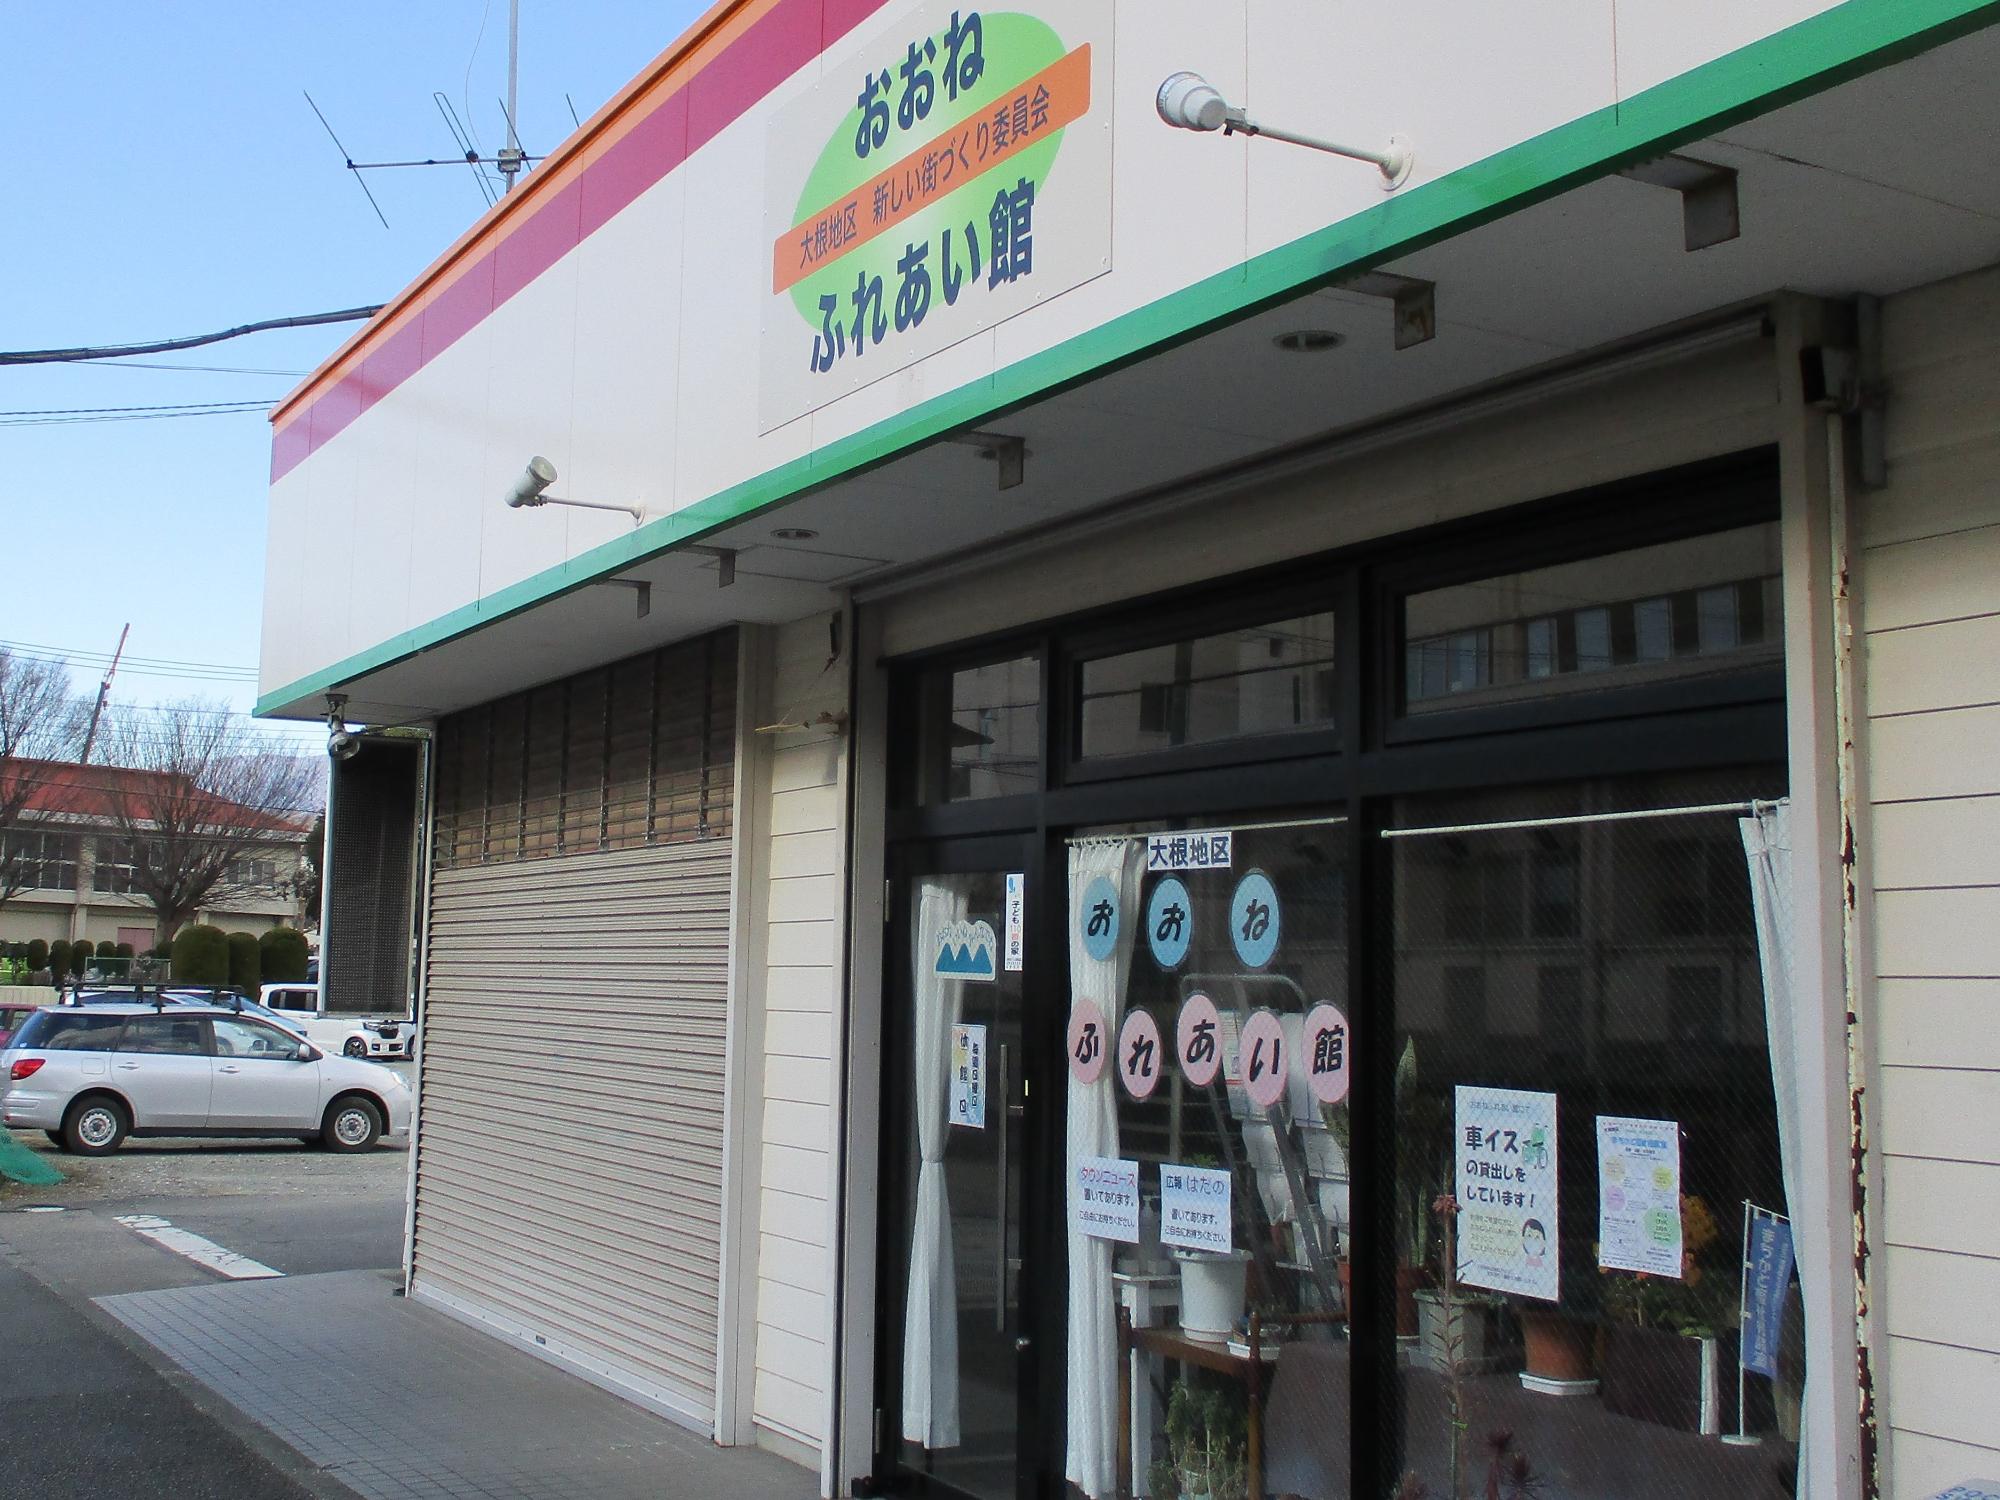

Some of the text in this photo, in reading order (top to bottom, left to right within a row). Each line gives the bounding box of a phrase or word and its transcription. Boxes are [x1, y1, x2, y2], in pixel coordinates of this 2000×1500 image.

[855, 10, 985, 158] おおね
[800, 84, 1050, 269] 大根地区 新しい街づくり委員会
[810, 177, 1035, 373] ふれあい館
[1150, 836, 1230, 868] 大根地区
[1088, 899, 1270, 941] おおね
[1075, 1023, 1344, 1082] ふれあい館
[1465, 1125, 1519, 1154] 車イス
[1081, 1167, 1136, 1188] タウンニュース
[1166, 1175, 1225, 1195] 広報 はだの
[1466, 1160, 1526, 1183] の貸出しを
[1467, 1186, 1535, 1208] しています！
